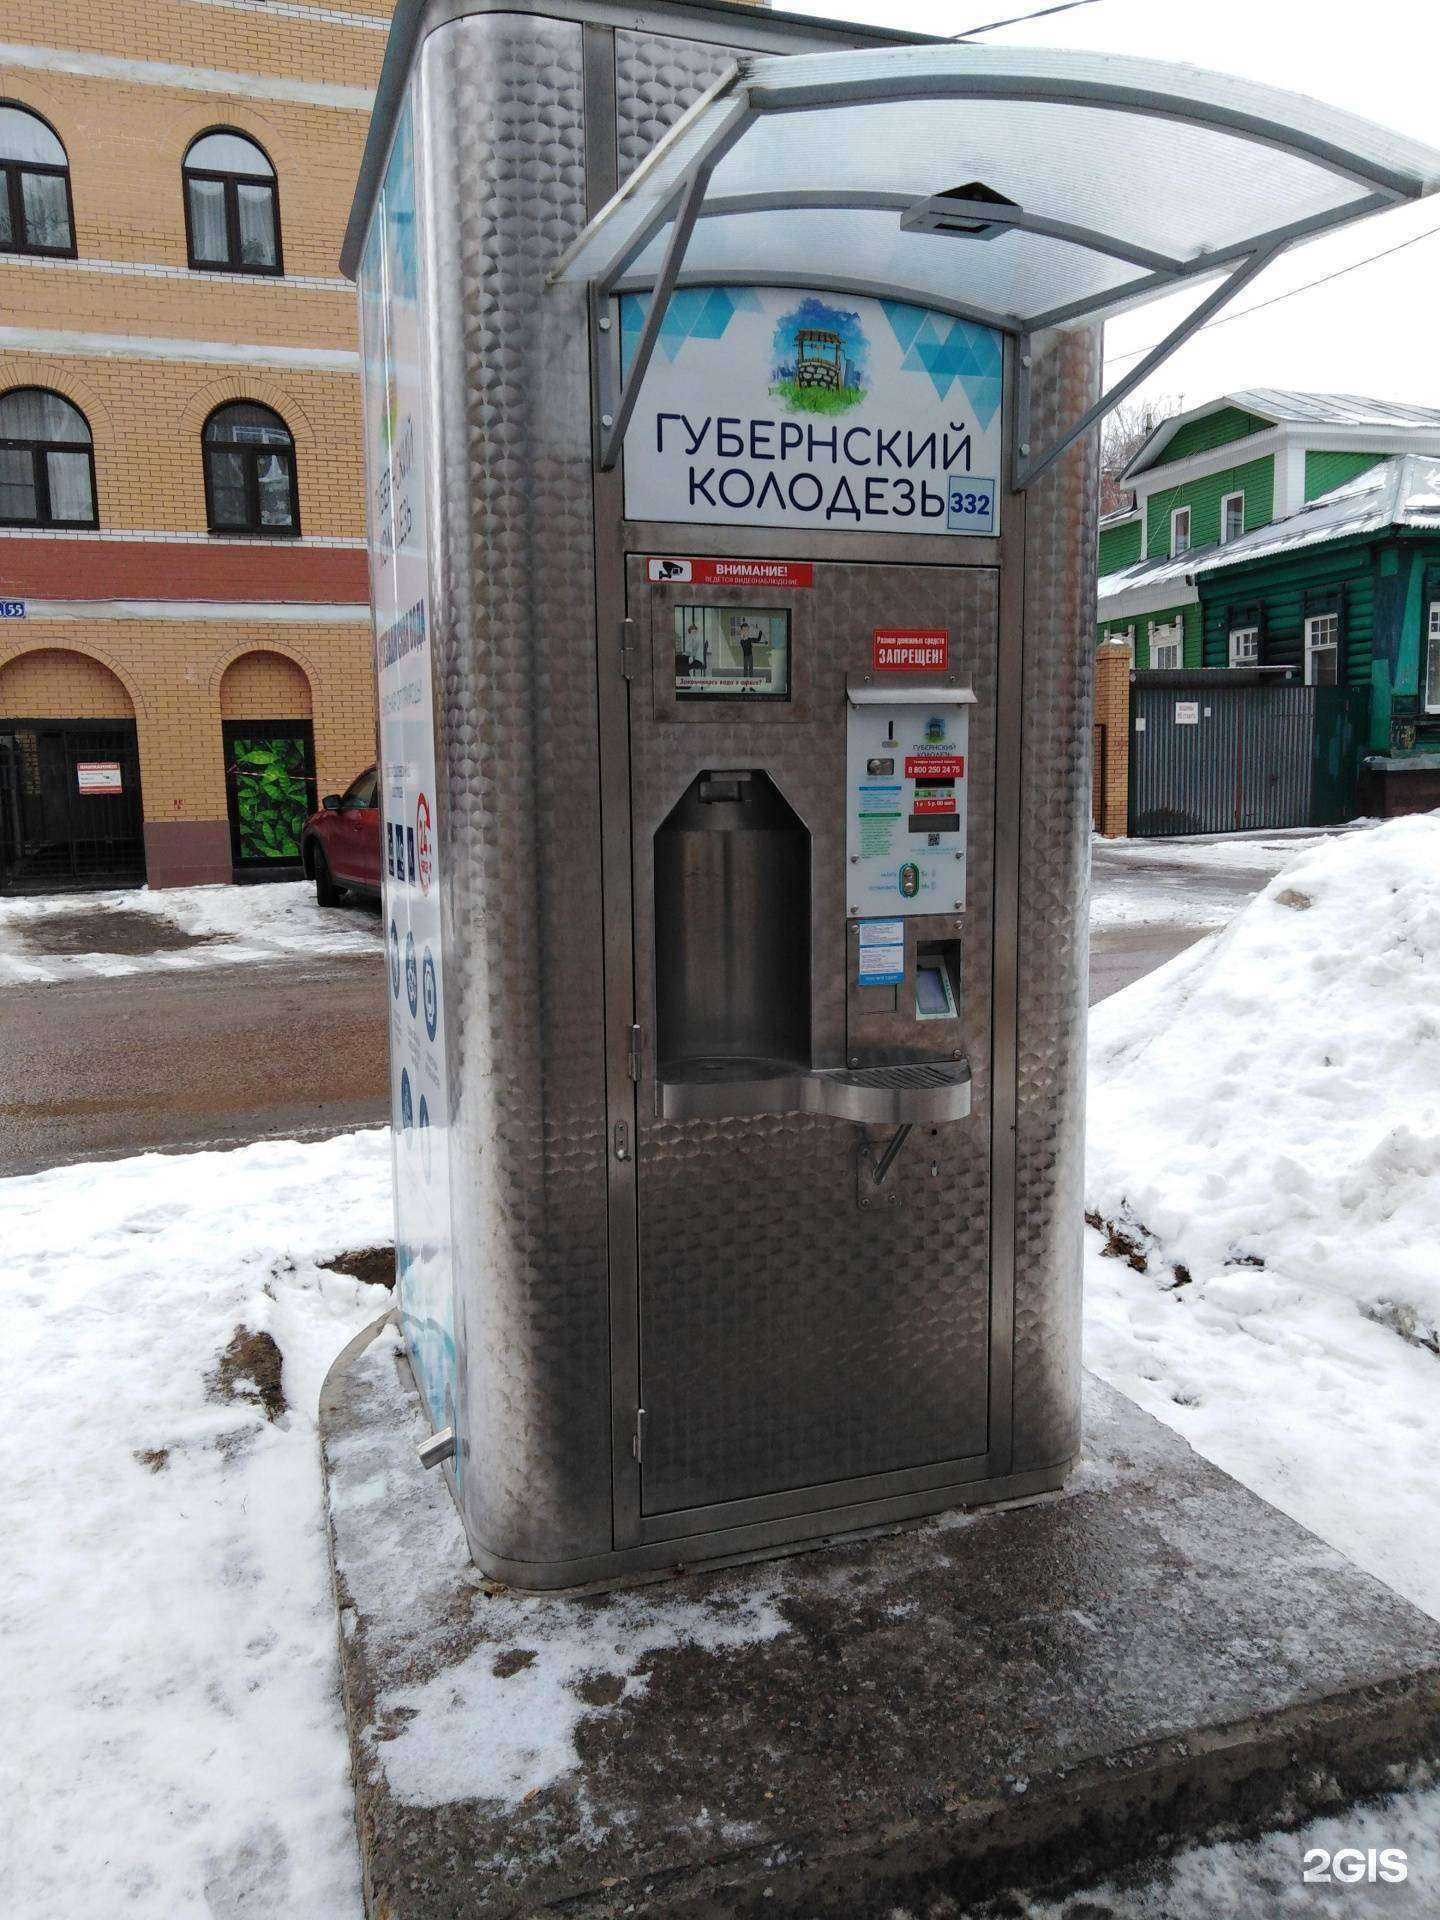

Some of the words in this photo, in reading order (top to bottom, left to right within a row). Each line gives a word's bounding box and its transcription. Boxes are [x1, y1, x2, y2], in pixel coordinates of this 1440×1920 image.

[657, 412, 971, 472] ГУБЕРНСКИЙ
[689, 466, 946, 522] КОЛОДЕЗЬ
[950, 491, 991, 516] 332
[716, 564, 788, 577] ВНИМАНИЕ!
[8, 604, 22, 616] 55
[879, 648, 943, 666] ЗАПРЕЩЕН!
